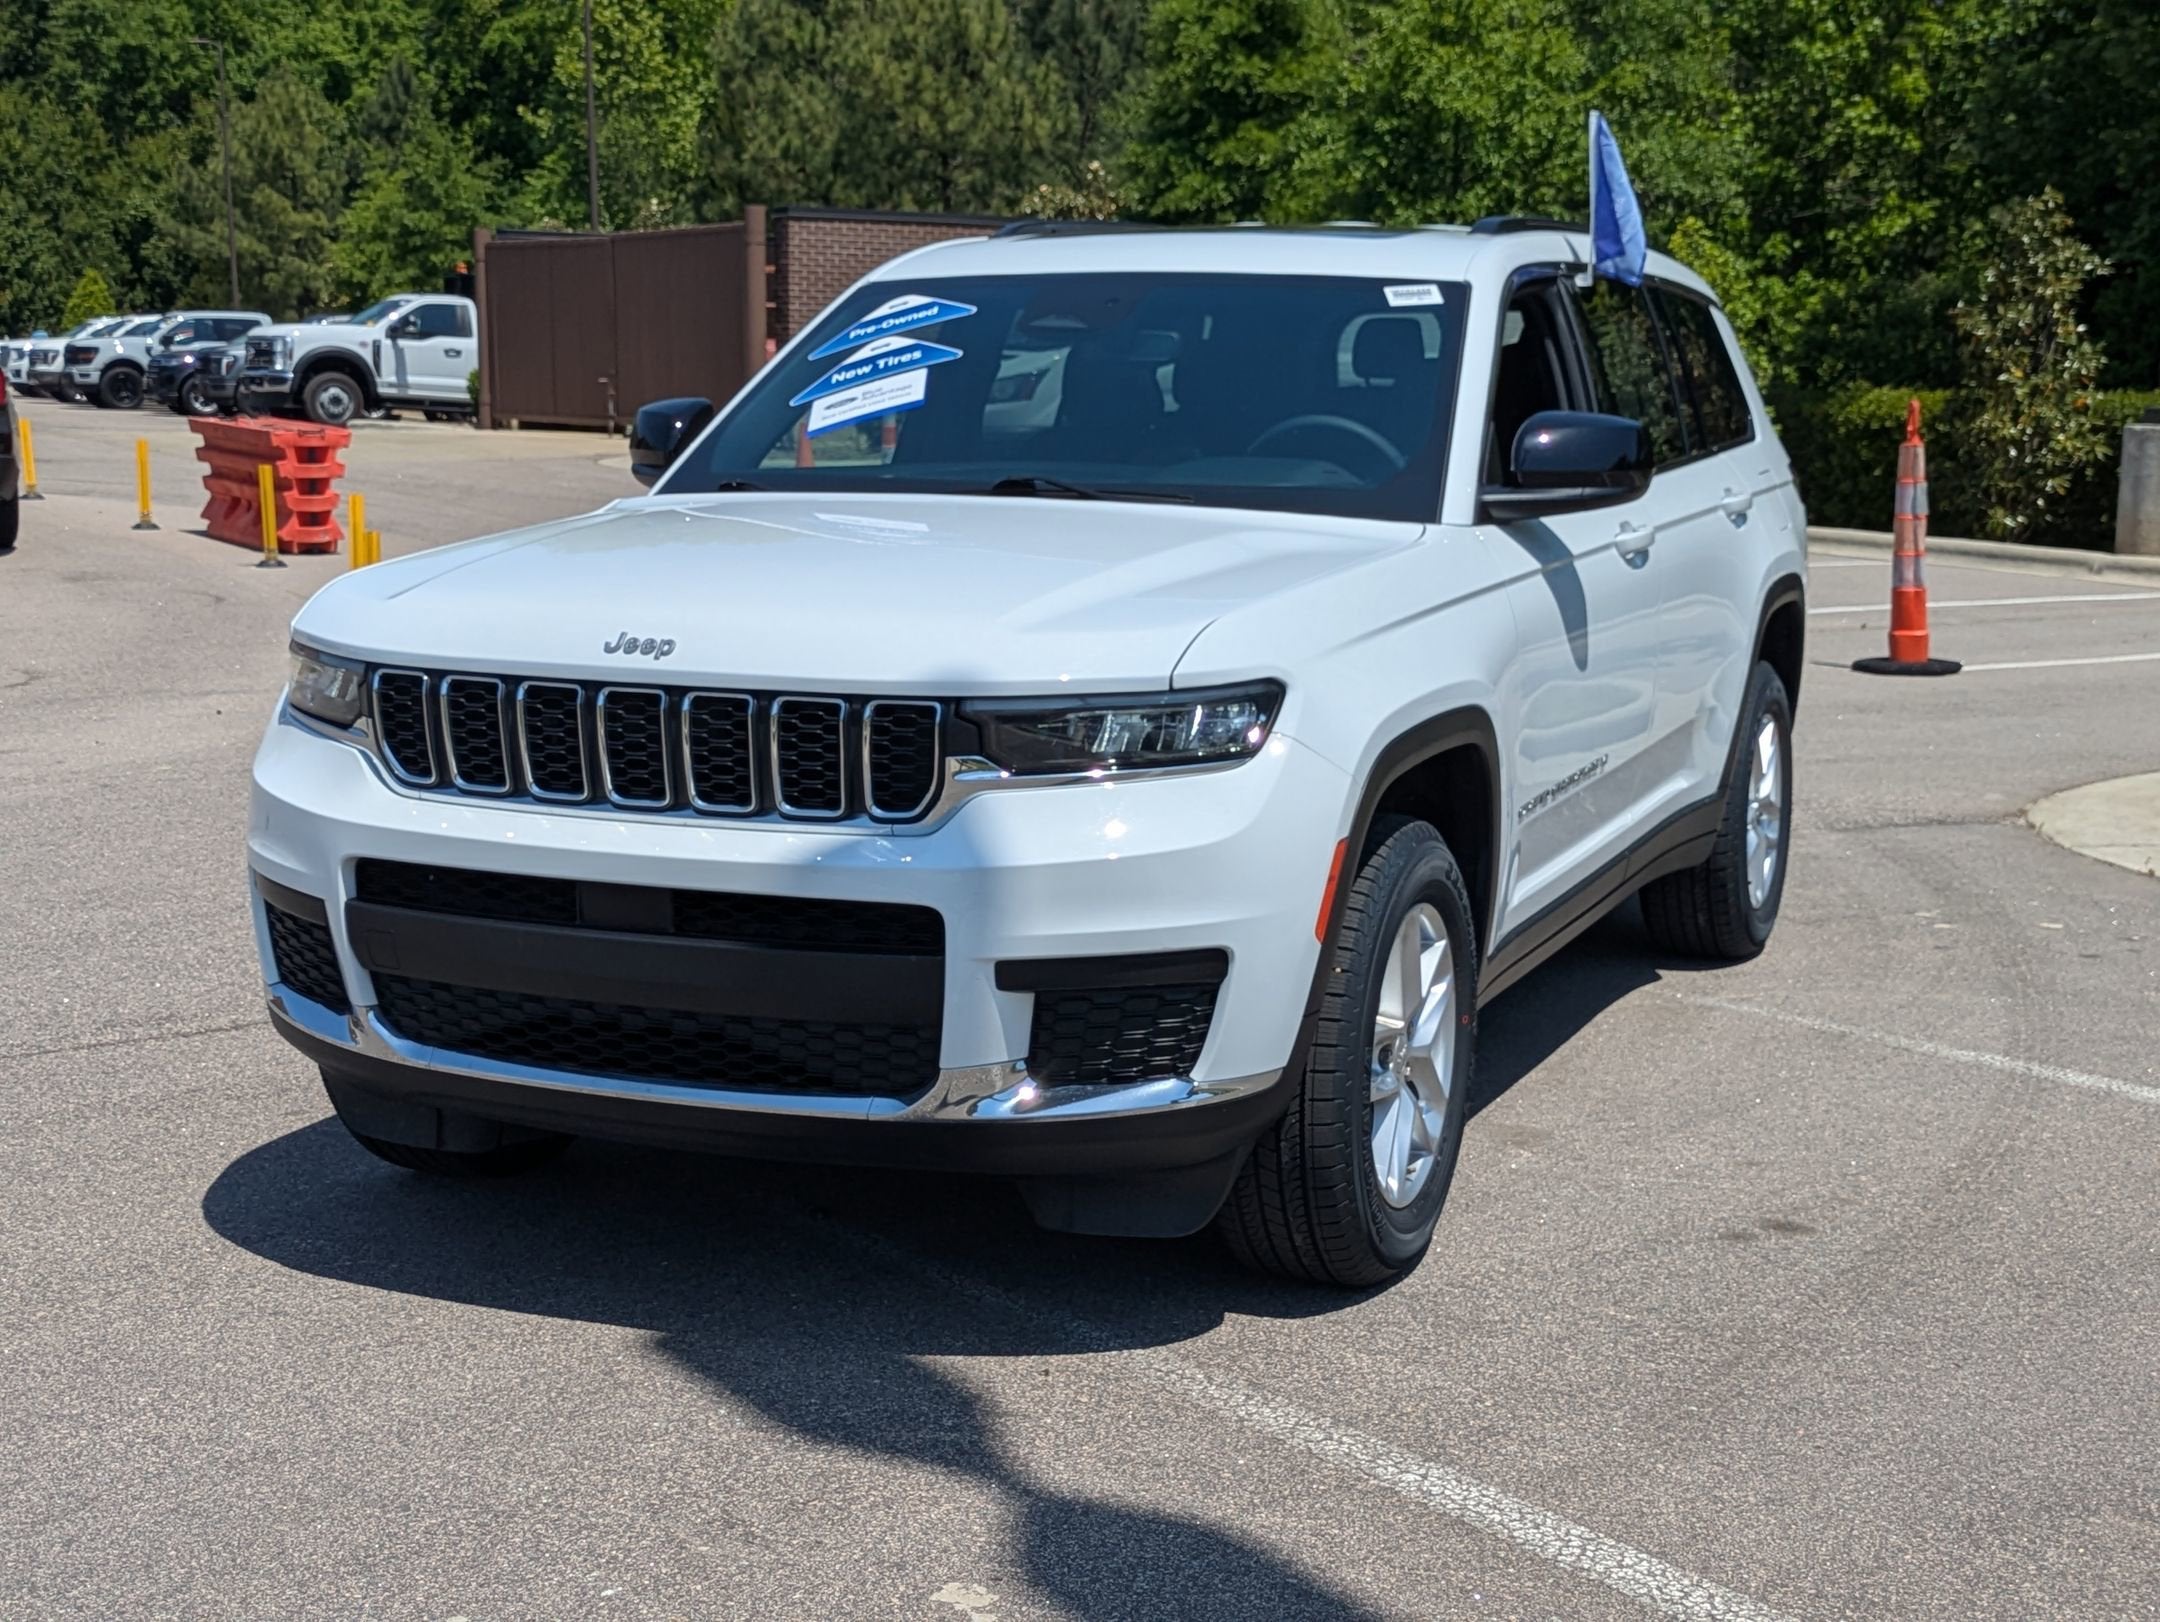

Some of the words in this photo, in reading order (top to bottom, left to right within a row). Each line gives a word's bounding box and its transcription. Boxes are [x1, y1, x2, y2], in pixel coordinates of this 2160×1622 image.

[849, 305, 940, 339] Pre-Owned
[831, 364, 873, 384] New
[876, 350, 922, 369] Tires
[603, 631, 677, 661] Jeep
